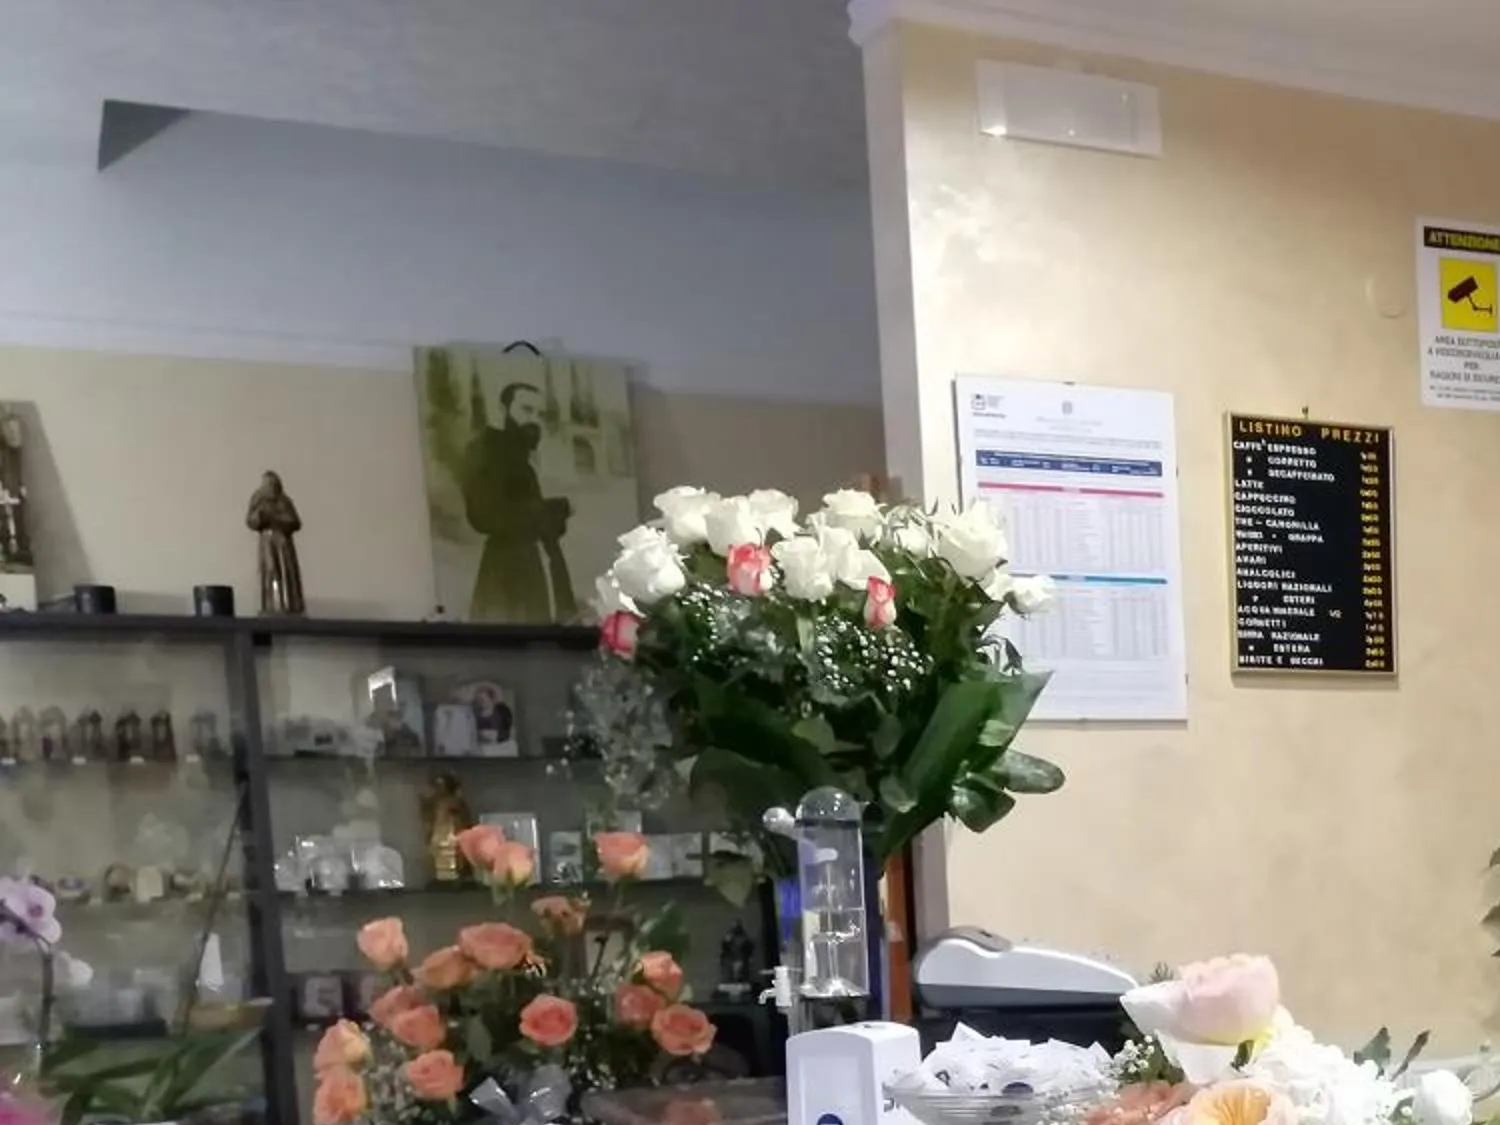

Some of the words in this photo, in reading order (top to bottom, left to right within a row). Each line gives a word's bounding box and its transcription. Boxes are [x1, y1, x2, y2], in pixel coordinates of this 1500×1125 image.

[1239, 421, 1302, 437] LISTINO
[1320, 427, 1379, 444] PREZZI
[1267, 456, 1317, 469] CORRETTO
[1235, 479, 1264, 489] LATTE
[1235, 491, 1296, 504] CAPPUCCINO
